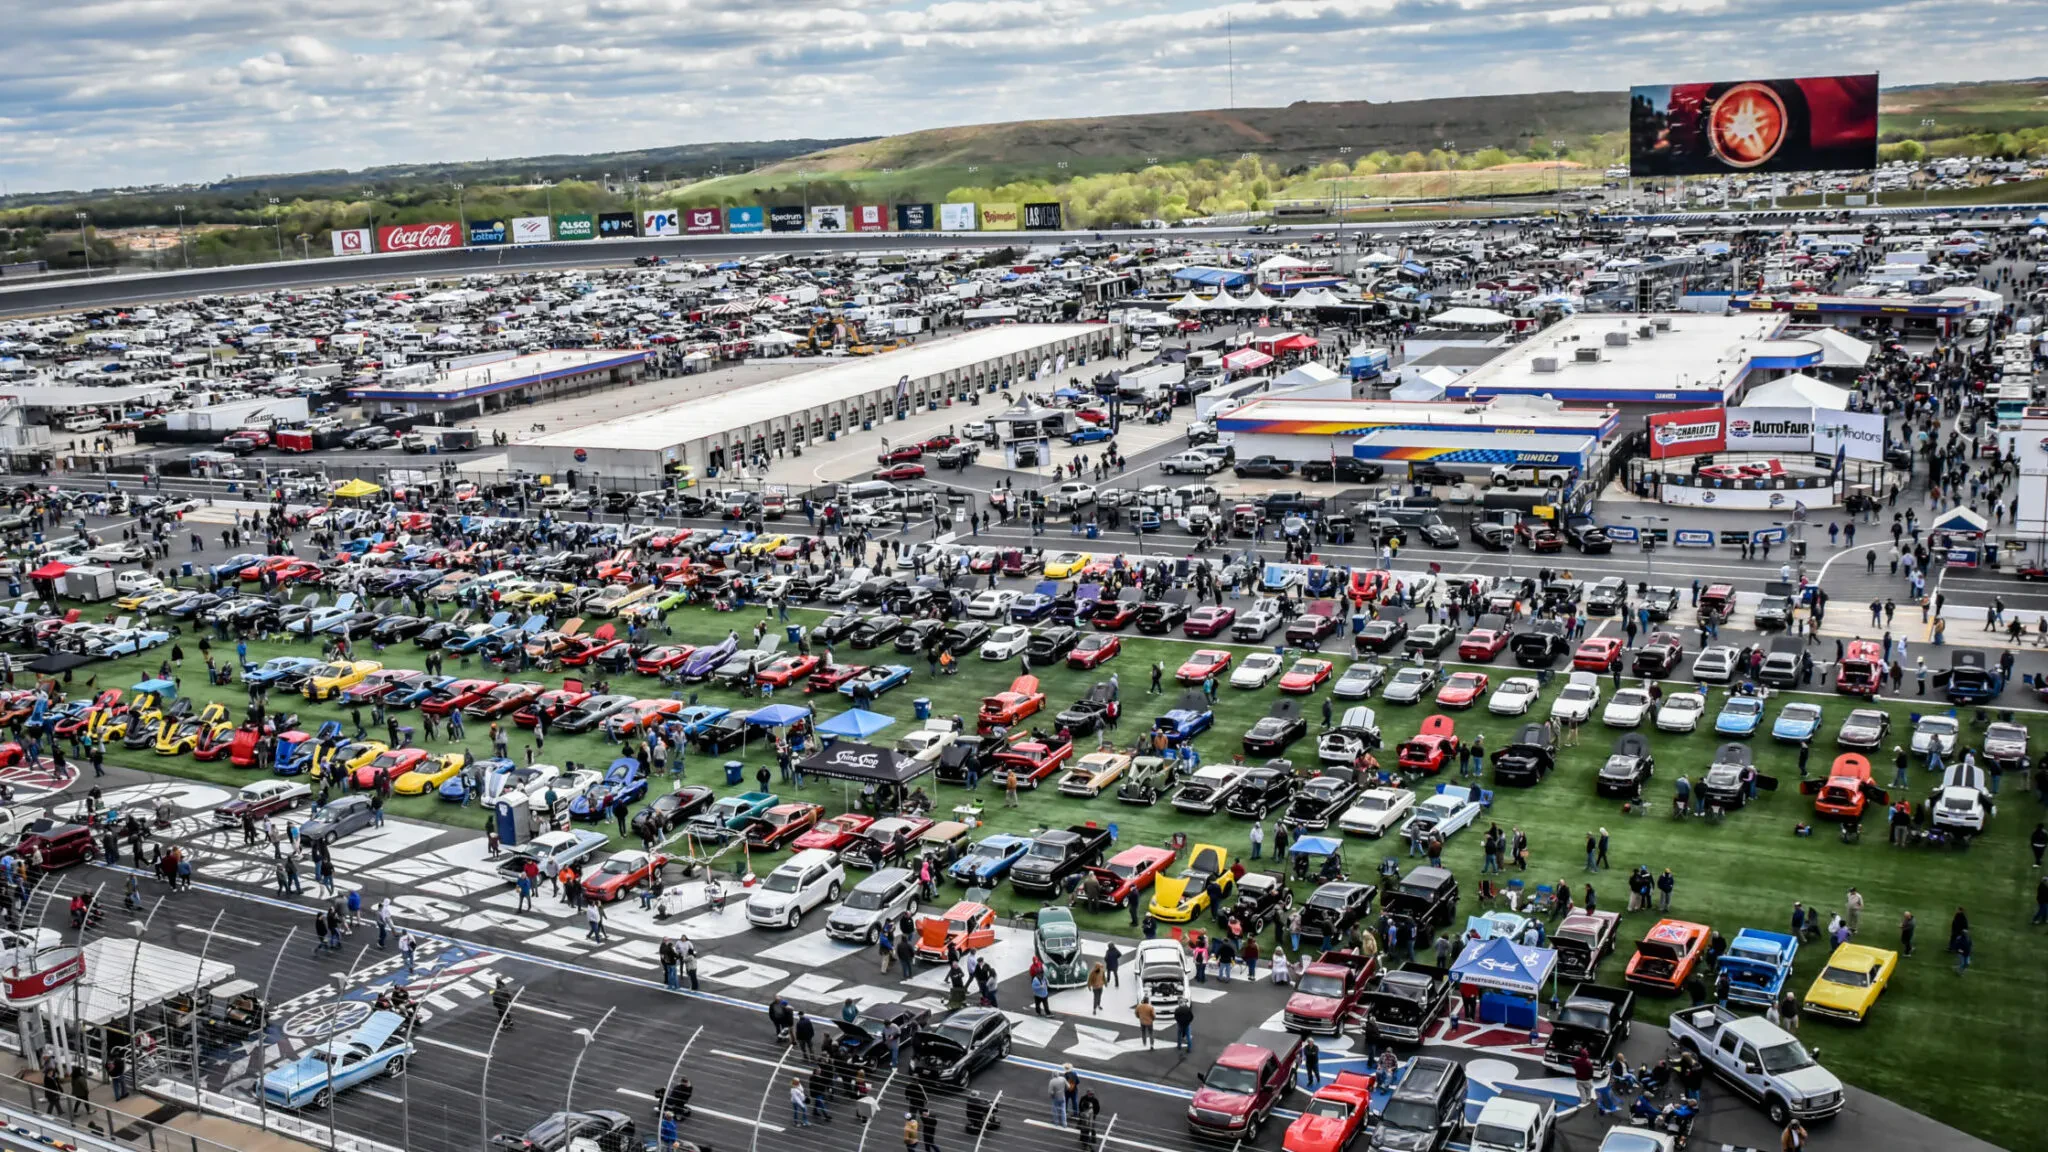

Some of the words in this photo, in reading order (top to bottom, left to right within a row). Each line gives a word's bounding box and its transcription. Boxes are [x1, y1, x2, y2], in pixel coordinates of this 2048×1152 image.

[771, 213, 801, 222] Spectrum
[1025, 207, 1039, 226] LAS
[1039, 206, 1060, 226] VEGAS
[559, 221, 591, 229] ALSCO
[621, 219, 633, 229] NC
[471, 232, 505, 242] Lottery
[1676, 424, 1717, 436] CHARLOTTE
[1844, 429, 1882, 443] motors
[1516, 453, 1559, 462] SUNOCO
[858, 753, 880, 768] Shop
